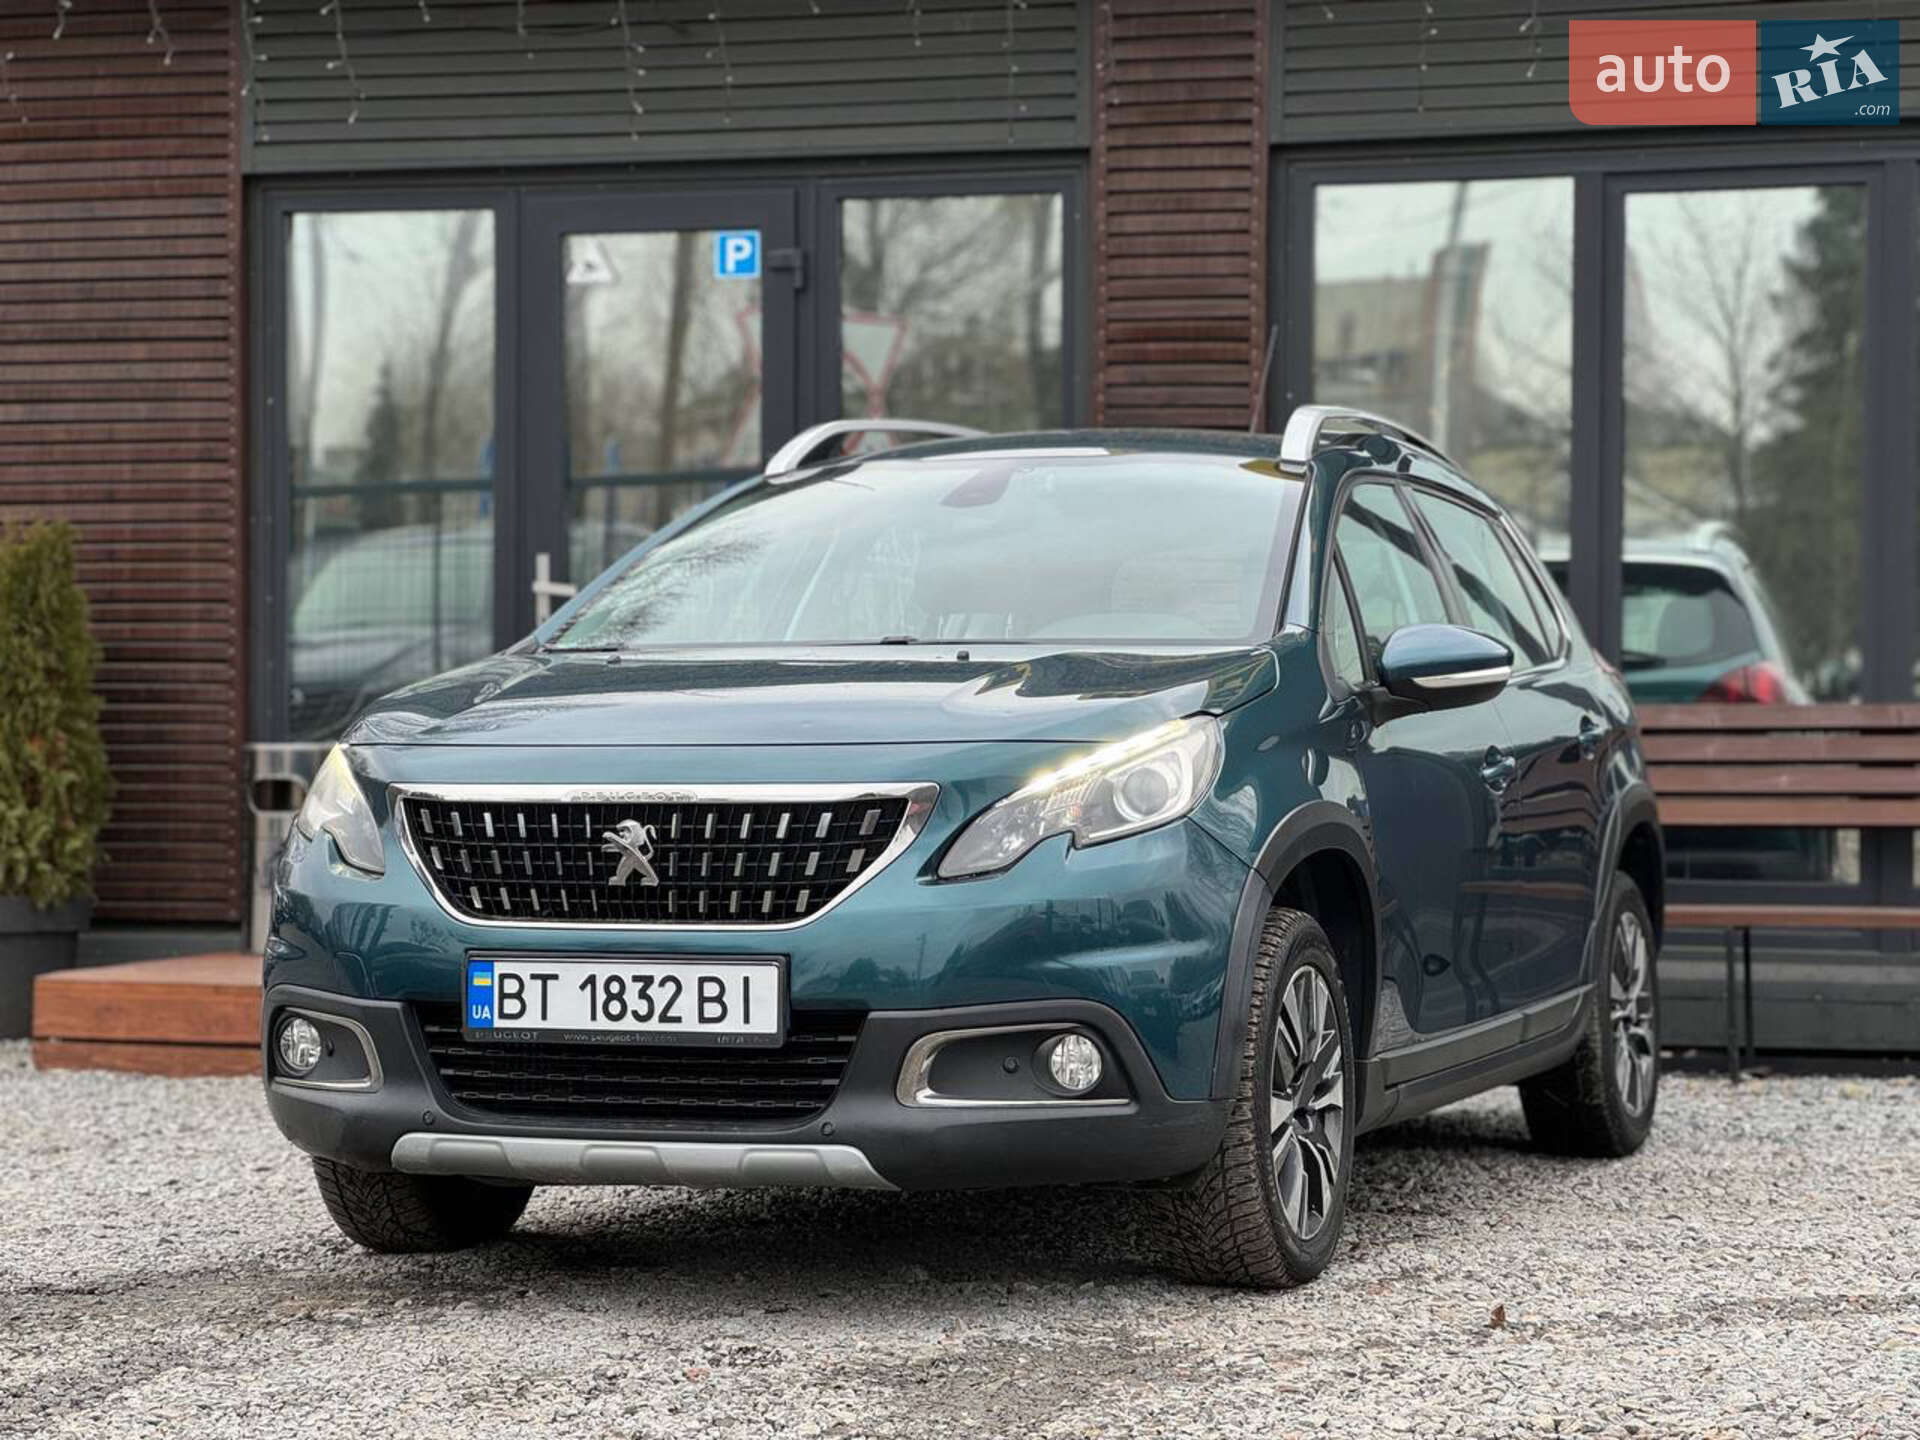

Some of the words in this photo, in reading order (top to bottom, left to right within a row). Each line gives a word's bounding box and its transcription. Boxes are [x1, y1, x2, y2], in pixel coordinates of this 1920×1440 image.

[725, 238, 753, 273] P
[472, 1004, 492, 1020] UA
[498, 972, 559, 1021] BT
[578, 973, 683, 1024] 1832
[697, 975, 750, 1025] BI
